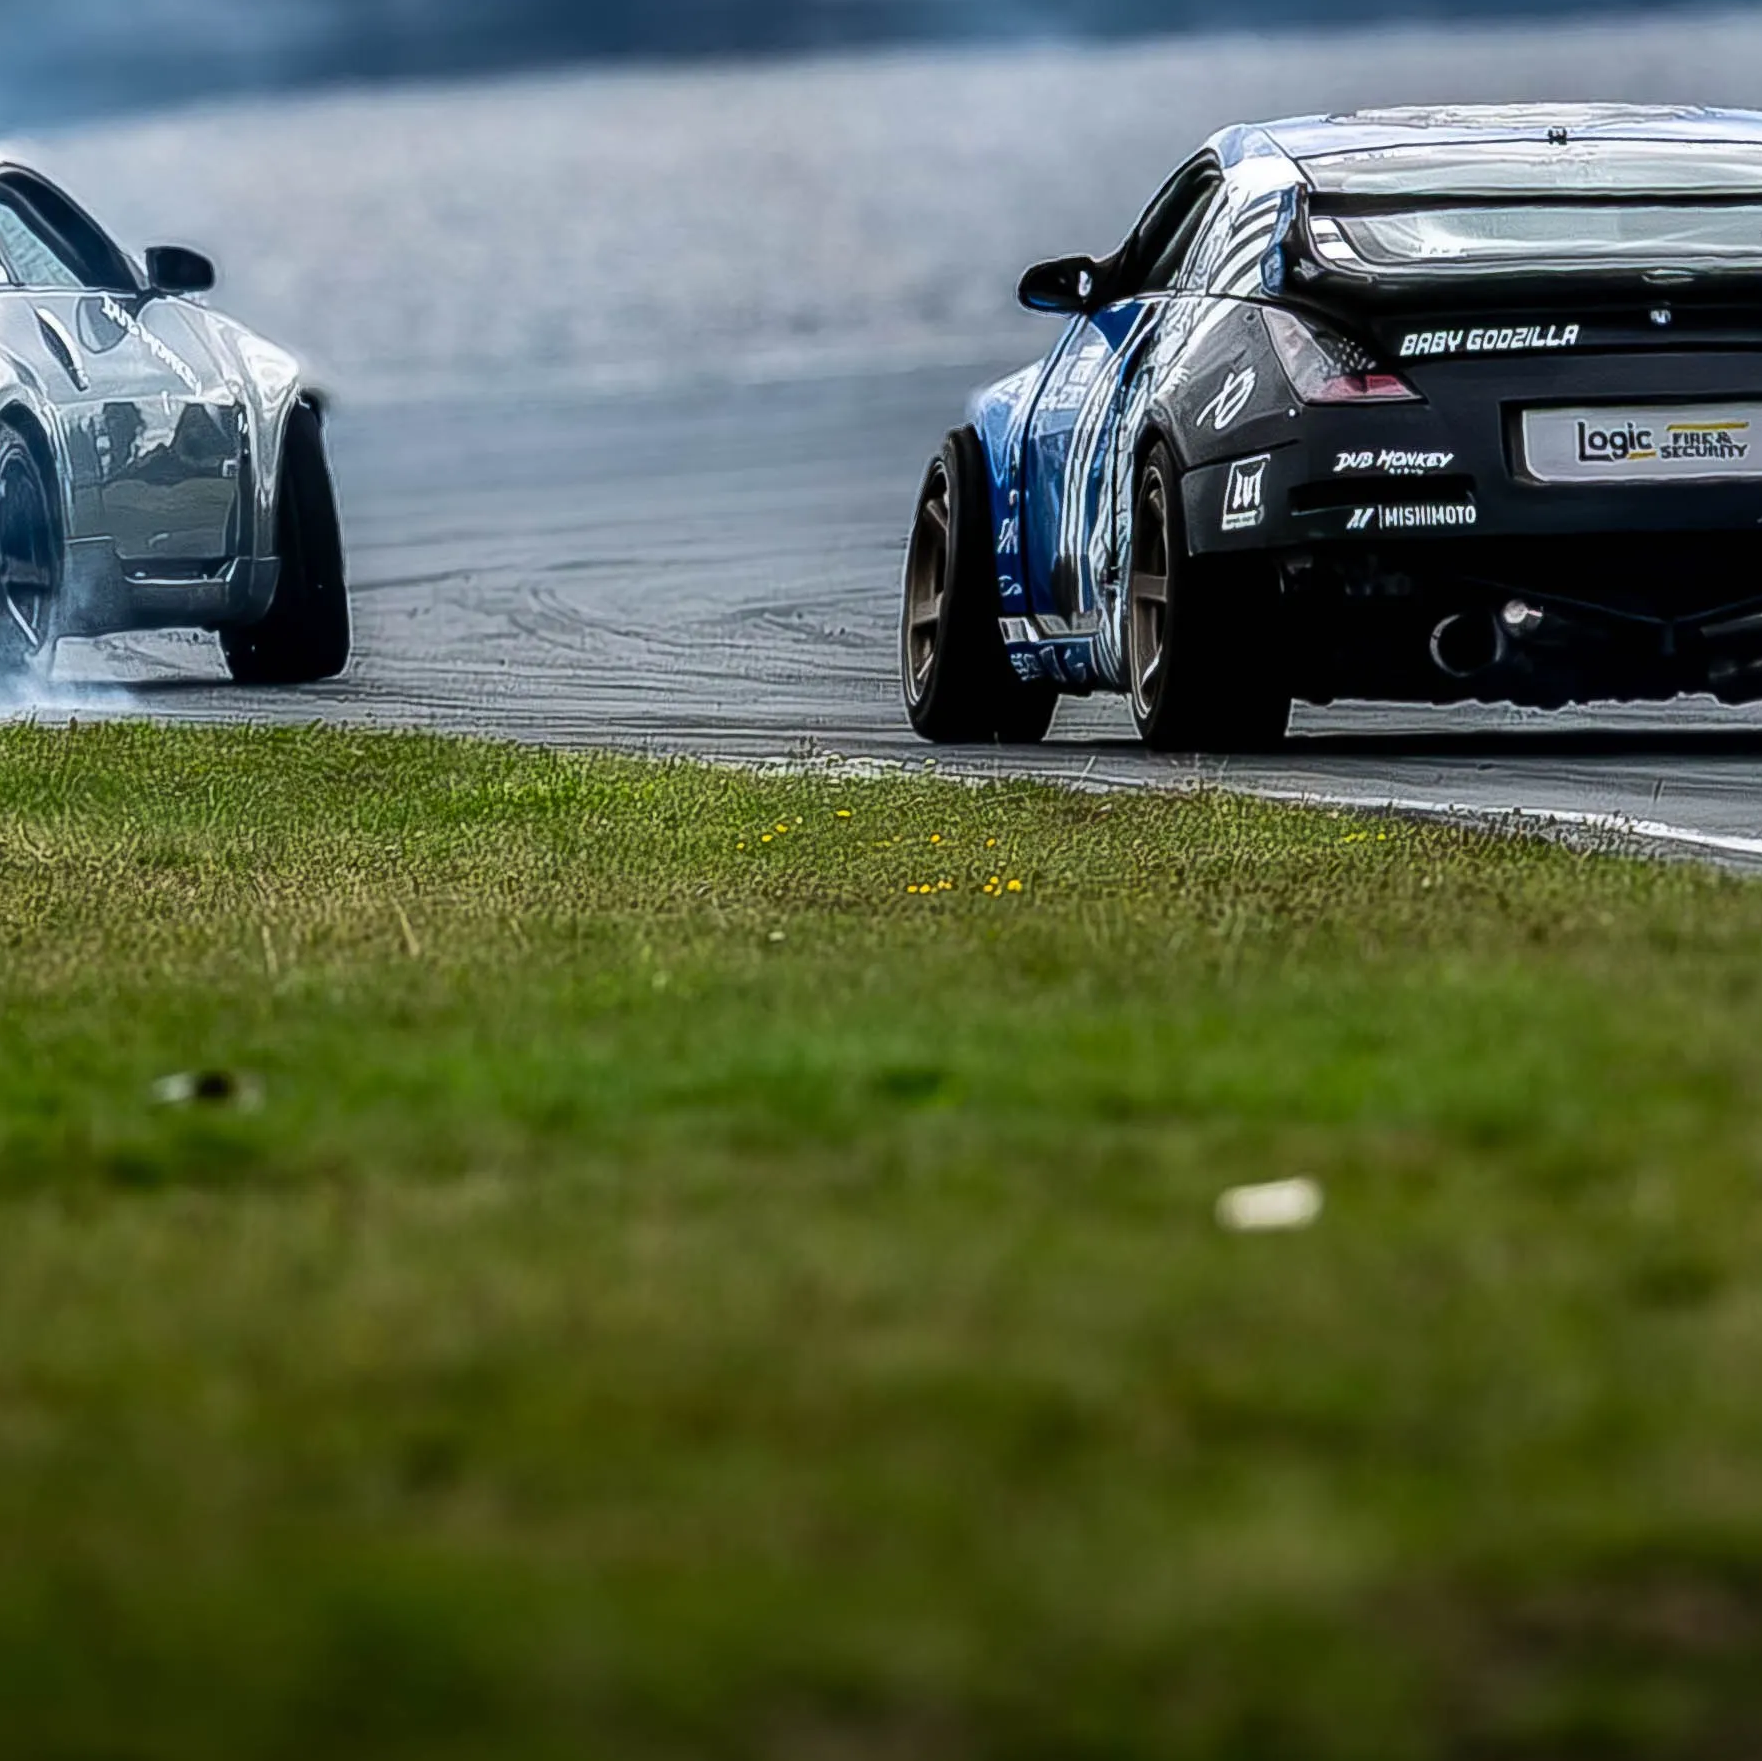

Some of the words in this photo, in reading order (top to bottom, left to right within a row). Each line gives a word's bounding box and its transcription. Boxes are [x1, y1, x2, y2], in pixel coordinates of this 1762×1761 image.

[1399, 330, 1464, 356] BABY
[1466, 324, 1580, 350] GODZILLA
[1577, 421, 1653, 462] Logic
[1660, 443, 1748, 458] SECURITY
[1333, 451, 1374, 472] DUB
[1376, 448, 1455, 470] MONKEY
[1385, 505, 1477, 528] MISHIMOTO
